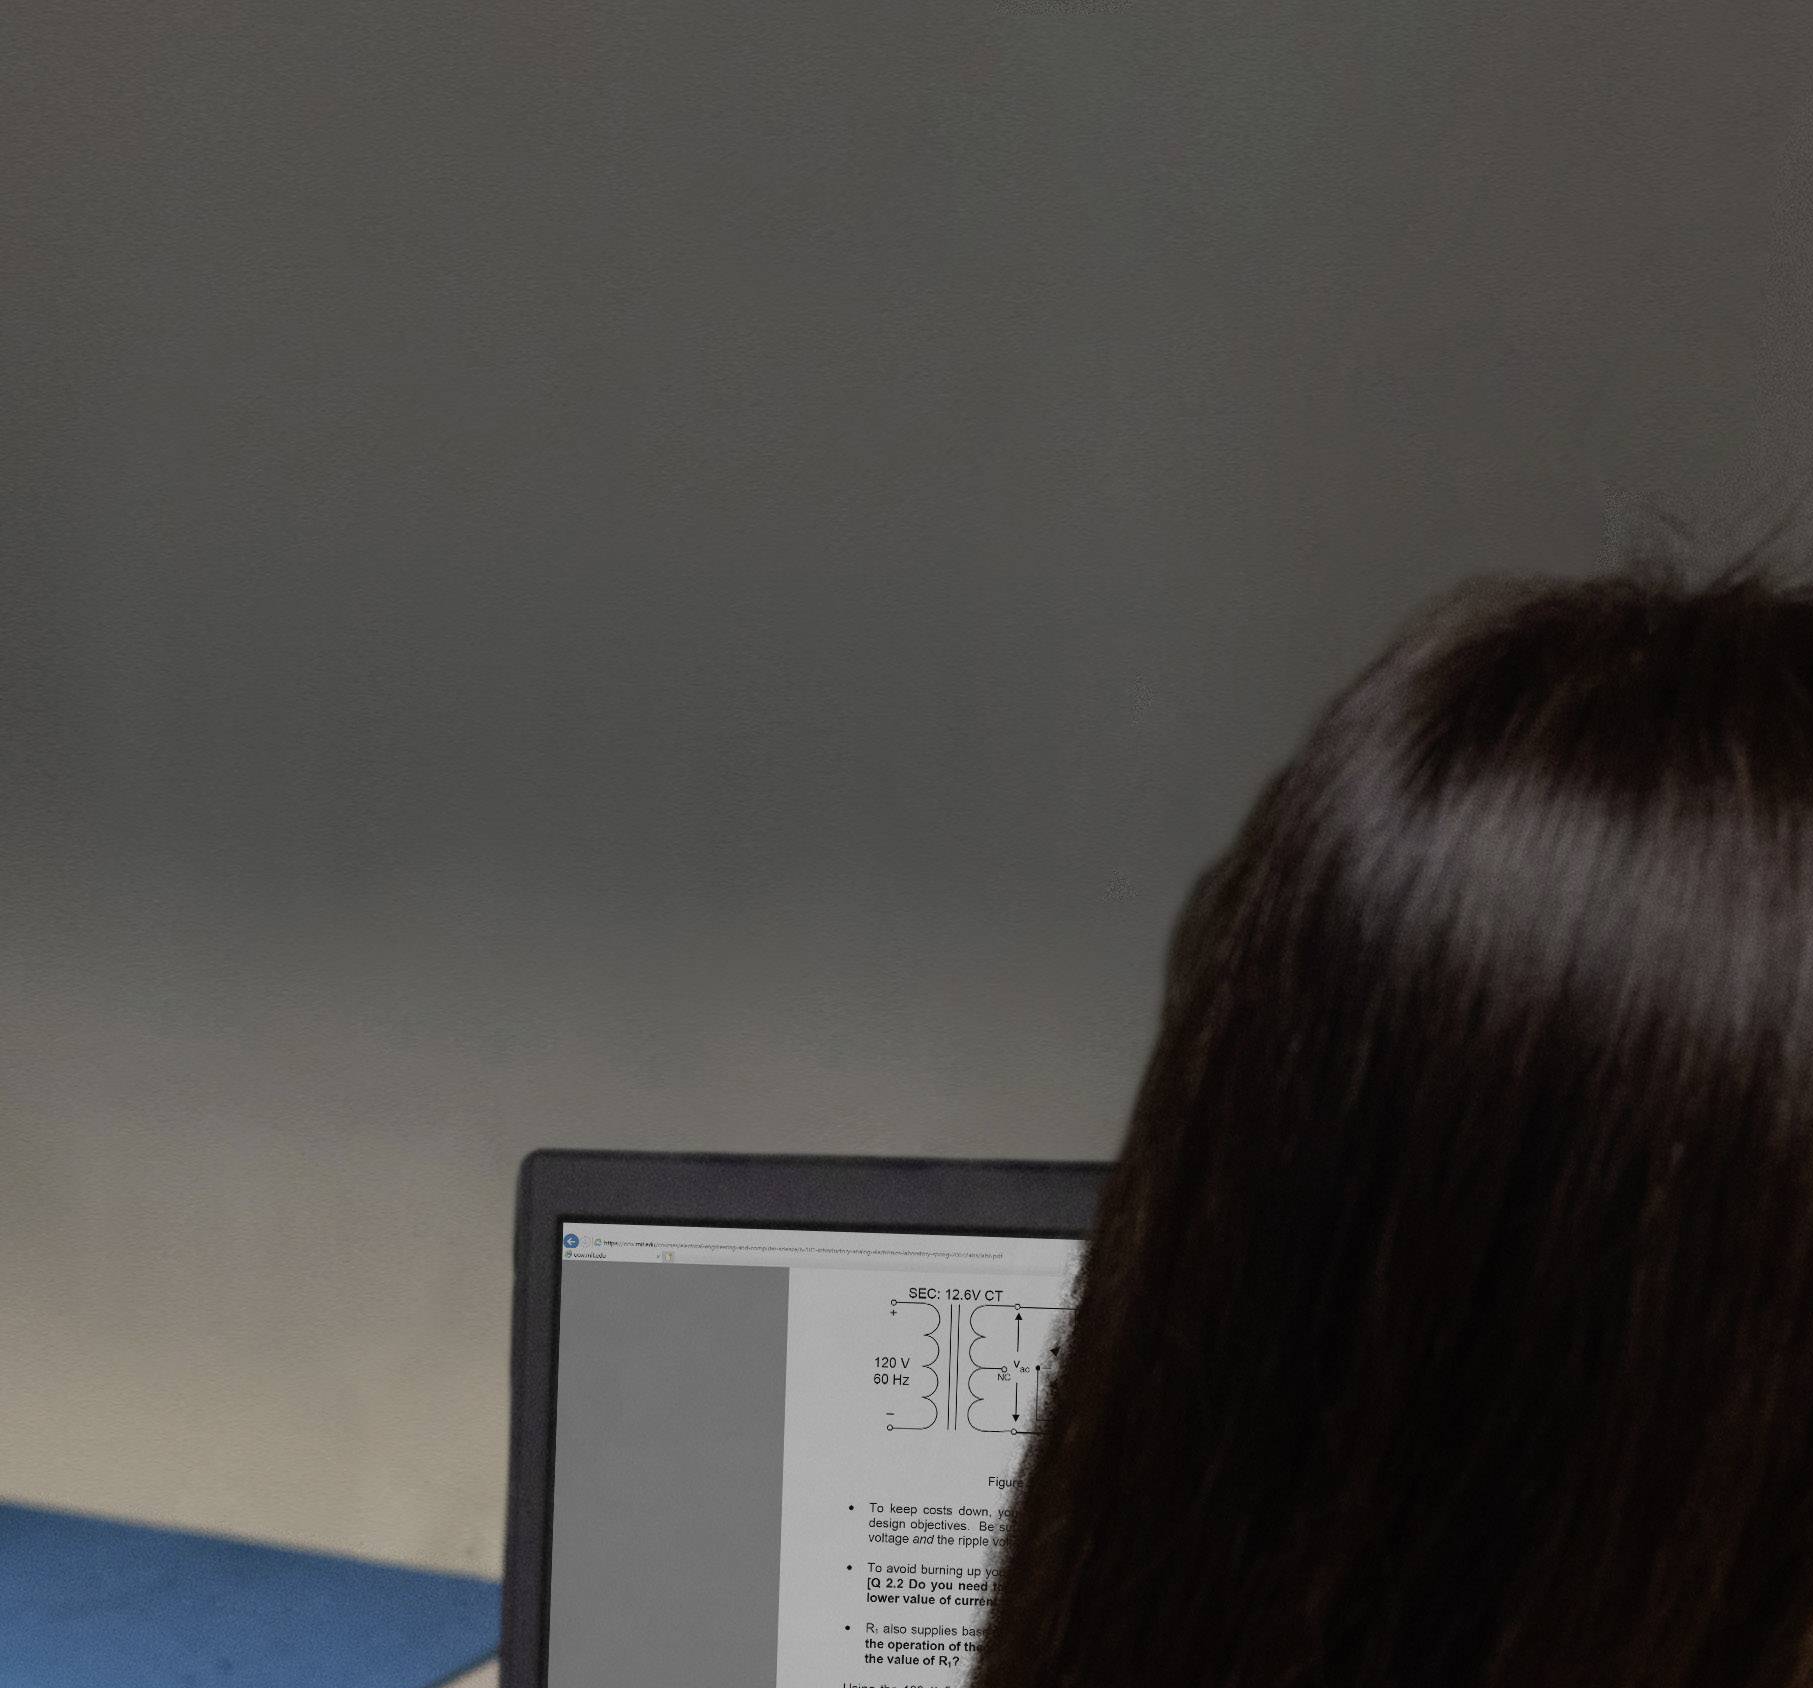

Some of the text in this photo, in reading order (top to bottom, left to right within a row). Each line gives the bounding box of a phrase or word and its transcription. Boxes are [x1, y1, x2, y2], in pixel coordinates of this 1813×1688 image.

[908, 1287, 1004, 1302] SEC: 12.6V CT
[874, 1357, 910, 1368] 120 V
[874, 1374, 910, 1386] 60 Hz
[997, 1374, 1011, 1382] NC
[988, 1476, 1024, 1490] Figure
[869, 1502, 992, 1518] To keep costs down,
[868, 1518, 994, 1532] design objectives. Be
[868, 1532, 989, 1548] voltage and the ripple
[868, 1562, 981, 1578] To avoid burning up
[867, 1578, 988, 1592] [Q 2.2 Do you need
[866, 1593, 993, 1606] lower value of curren
[865, 1654, 936, 1666] the value of
